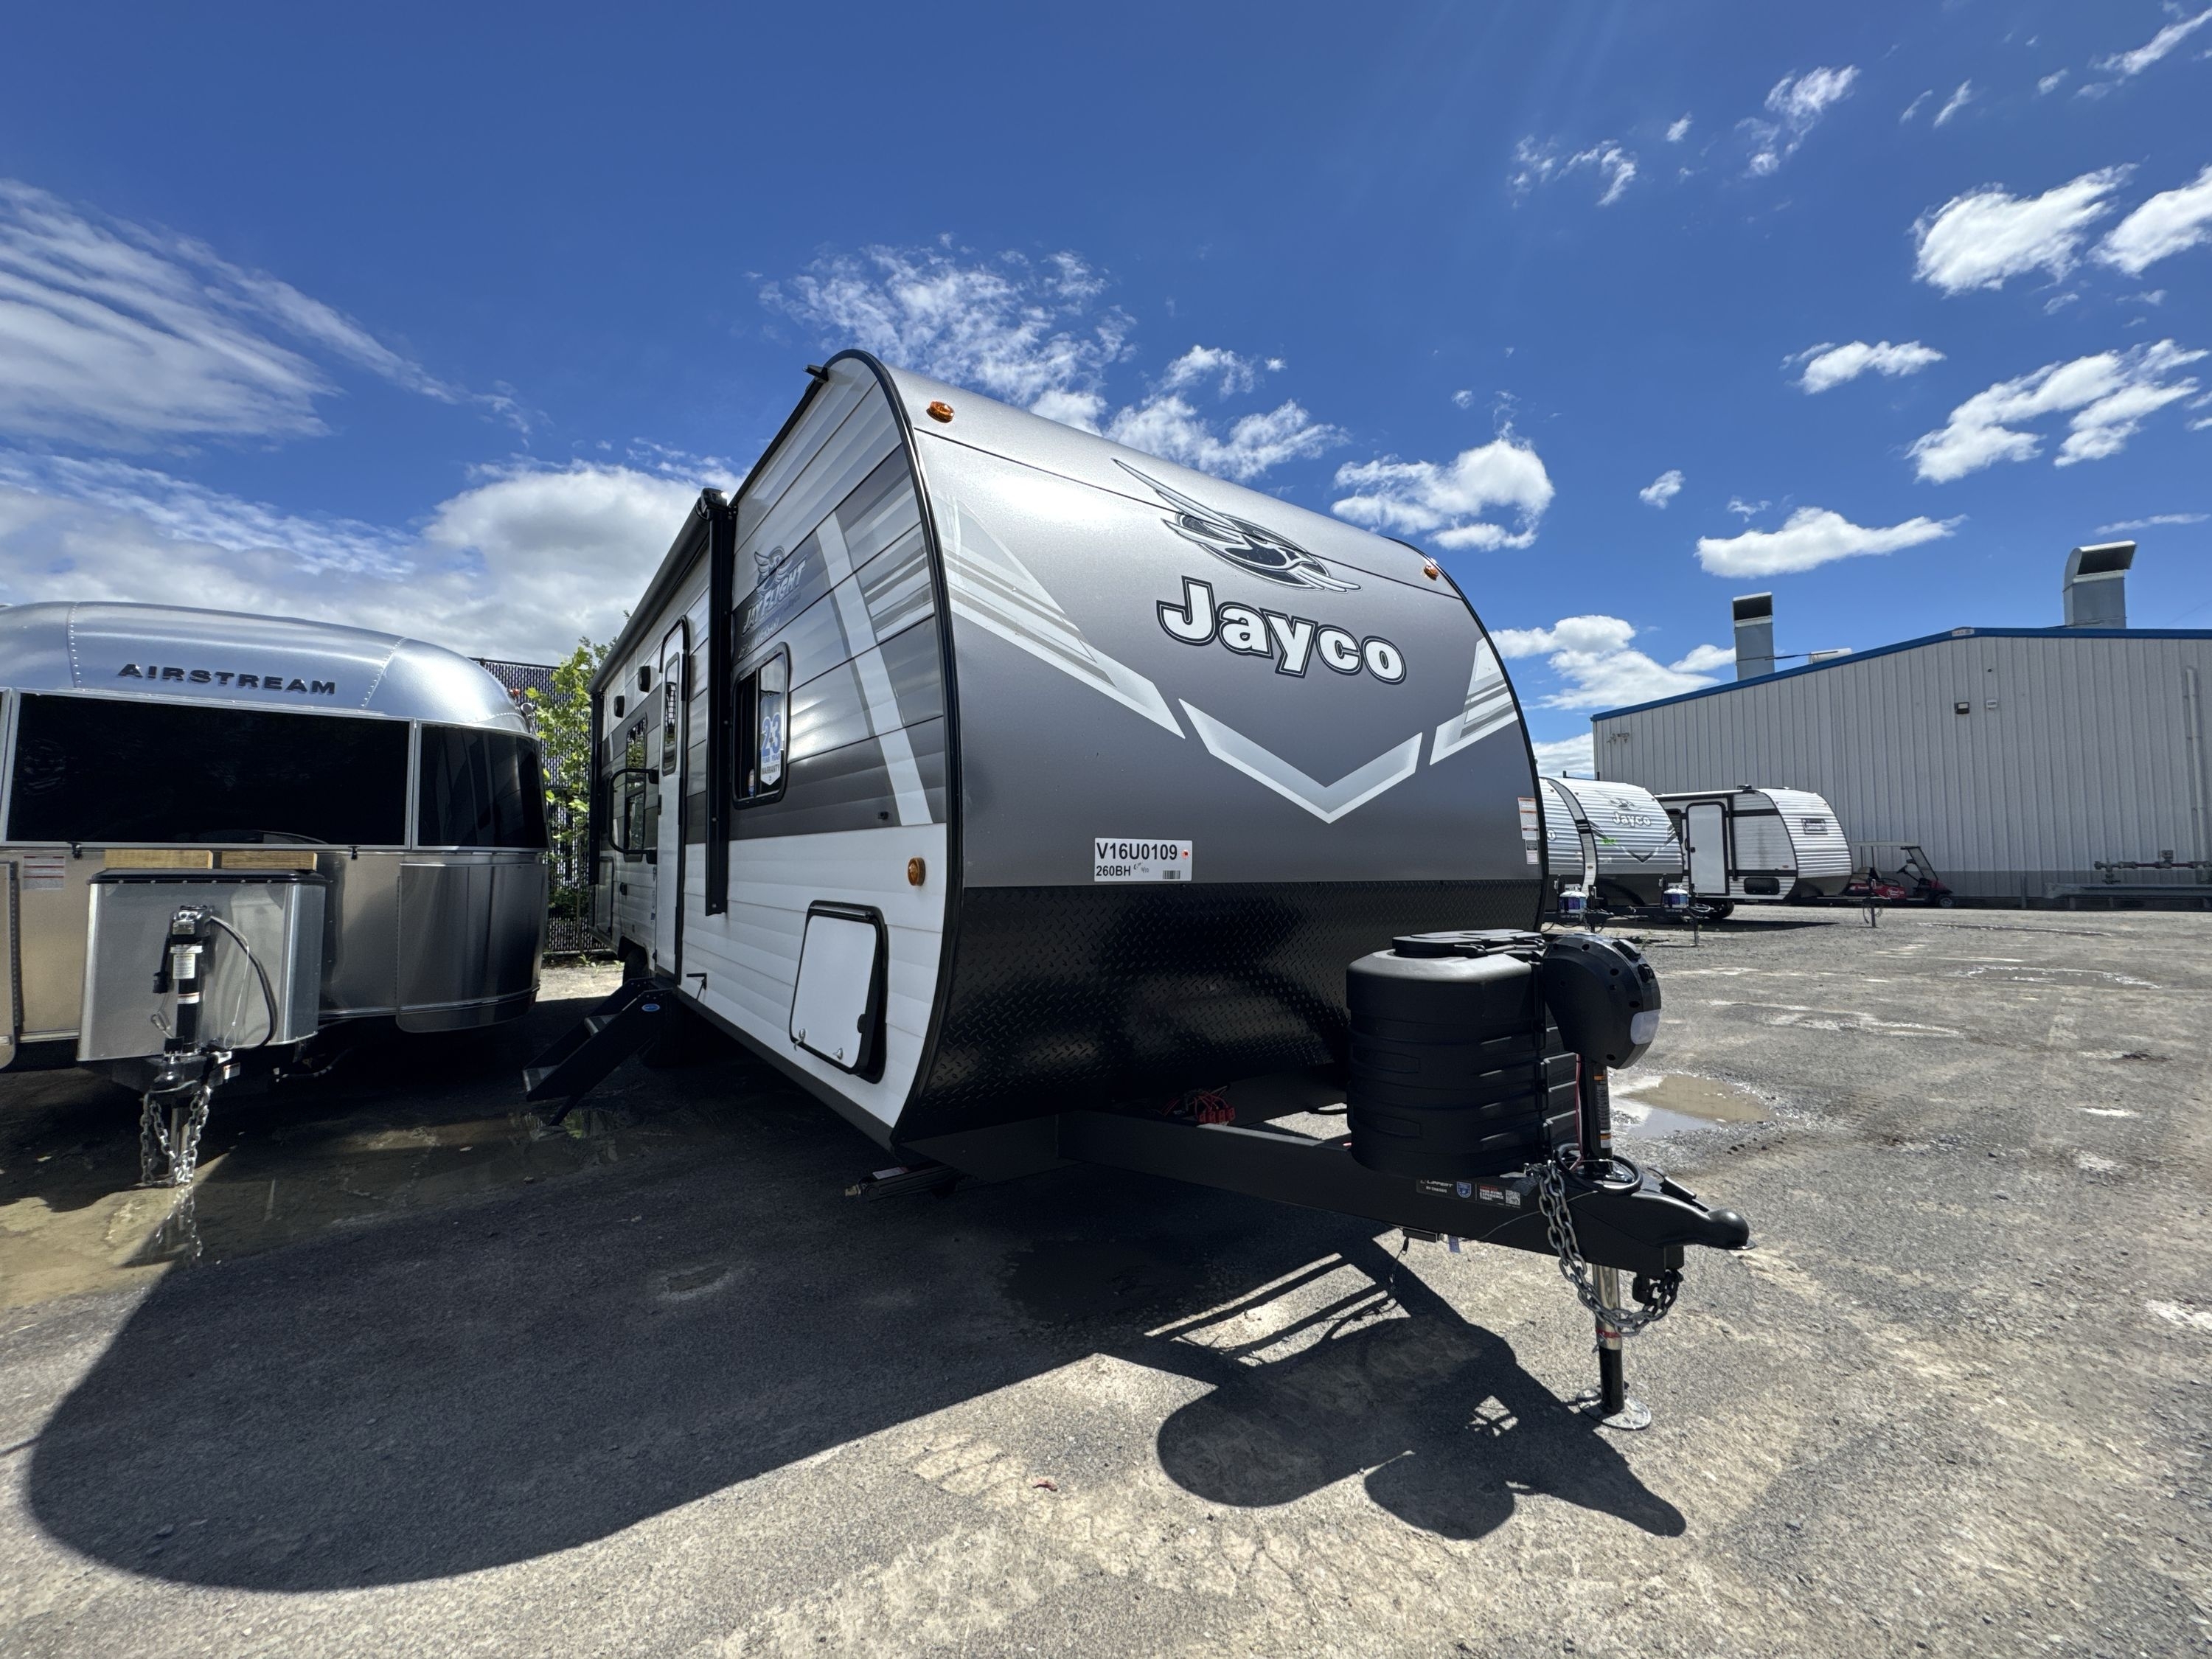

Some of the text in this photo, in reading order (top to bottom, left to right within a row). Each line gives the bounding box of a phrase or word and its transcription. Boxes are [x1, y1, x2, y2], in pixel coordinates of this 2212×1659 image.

[1156, 575, 1407, 685] Jayco
[118, 664, 335, 695] AIRSTREAM
[1612, 811, 1652, 827] Jayco
[1096, 842, 1178, 860] V16U0109
[1096, 865, 1131, 877] 260BH
